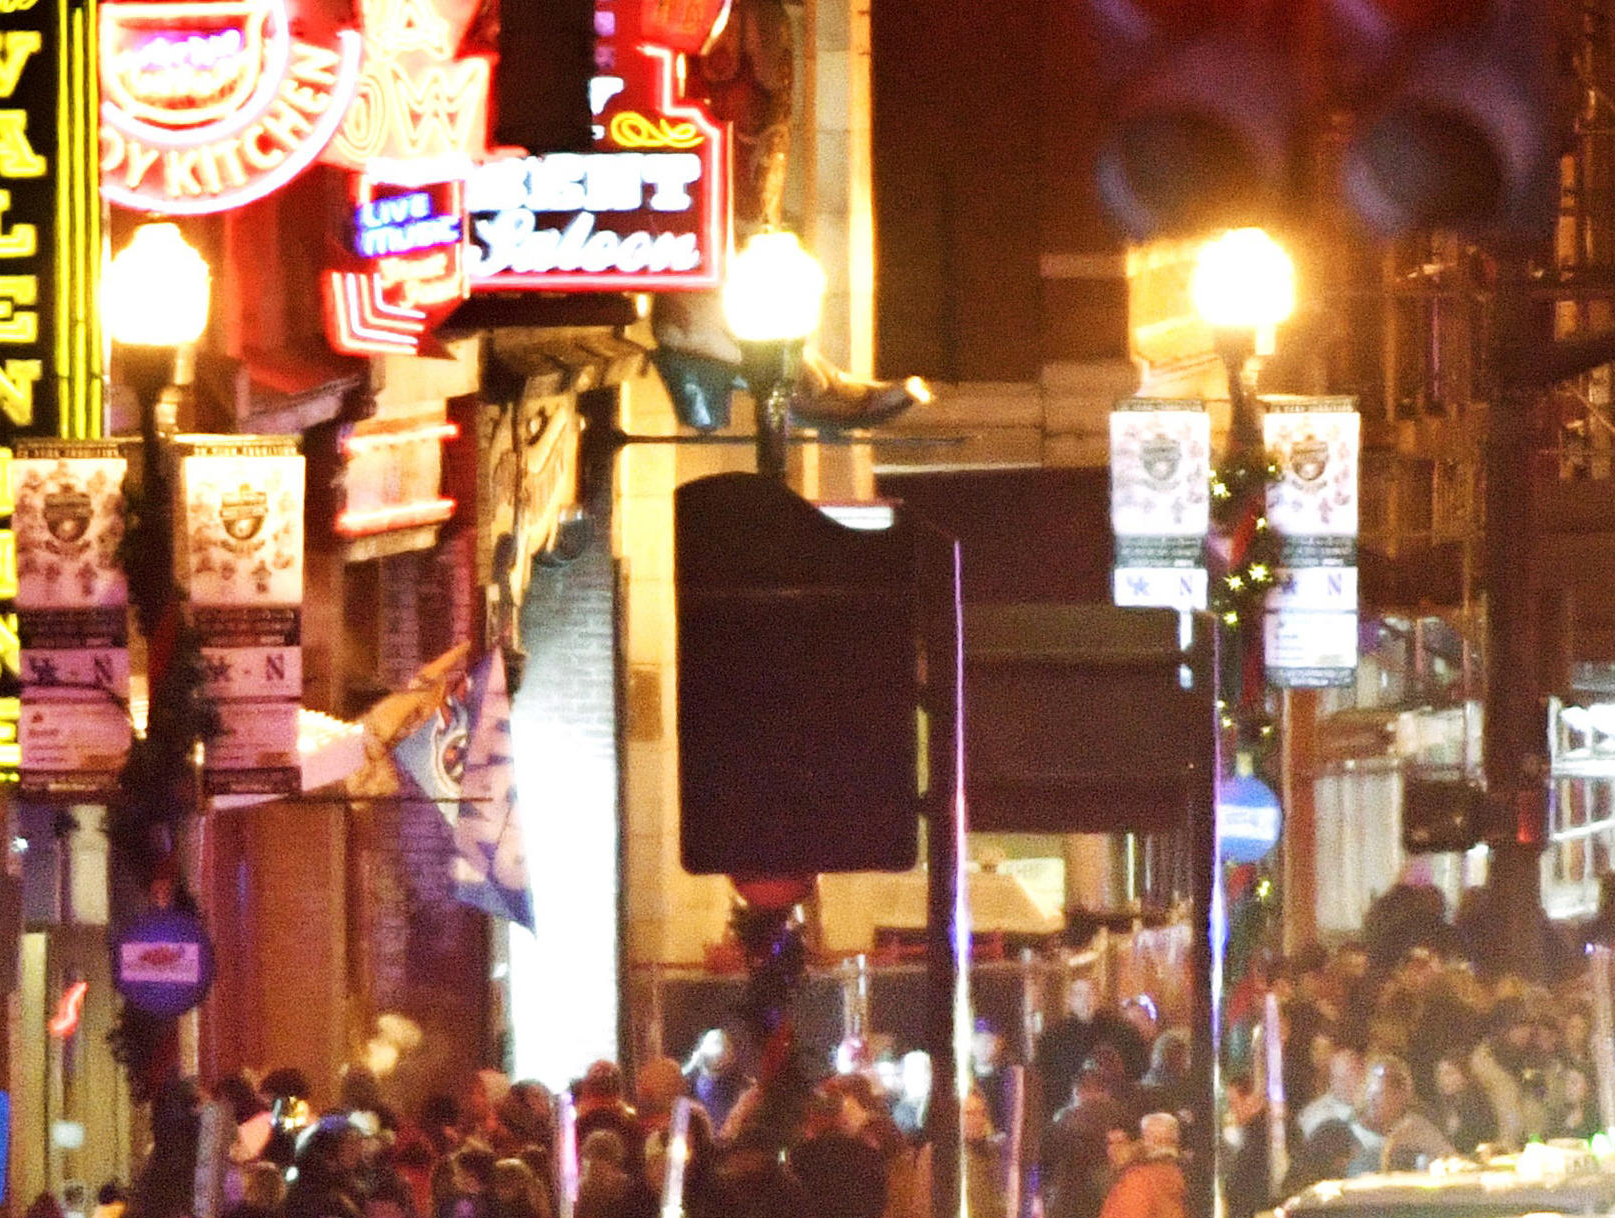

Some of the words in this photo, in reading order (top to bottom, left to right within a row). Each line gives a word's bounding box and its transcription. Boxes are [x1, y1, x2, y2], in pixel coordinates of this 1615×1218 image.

[165, 42, 340, 198] KITCHEN
[359, 215, 462, 257] MUSIC
[360, 192, 431, 228] LIVE
[462, 209, 701, 278] Saloon
